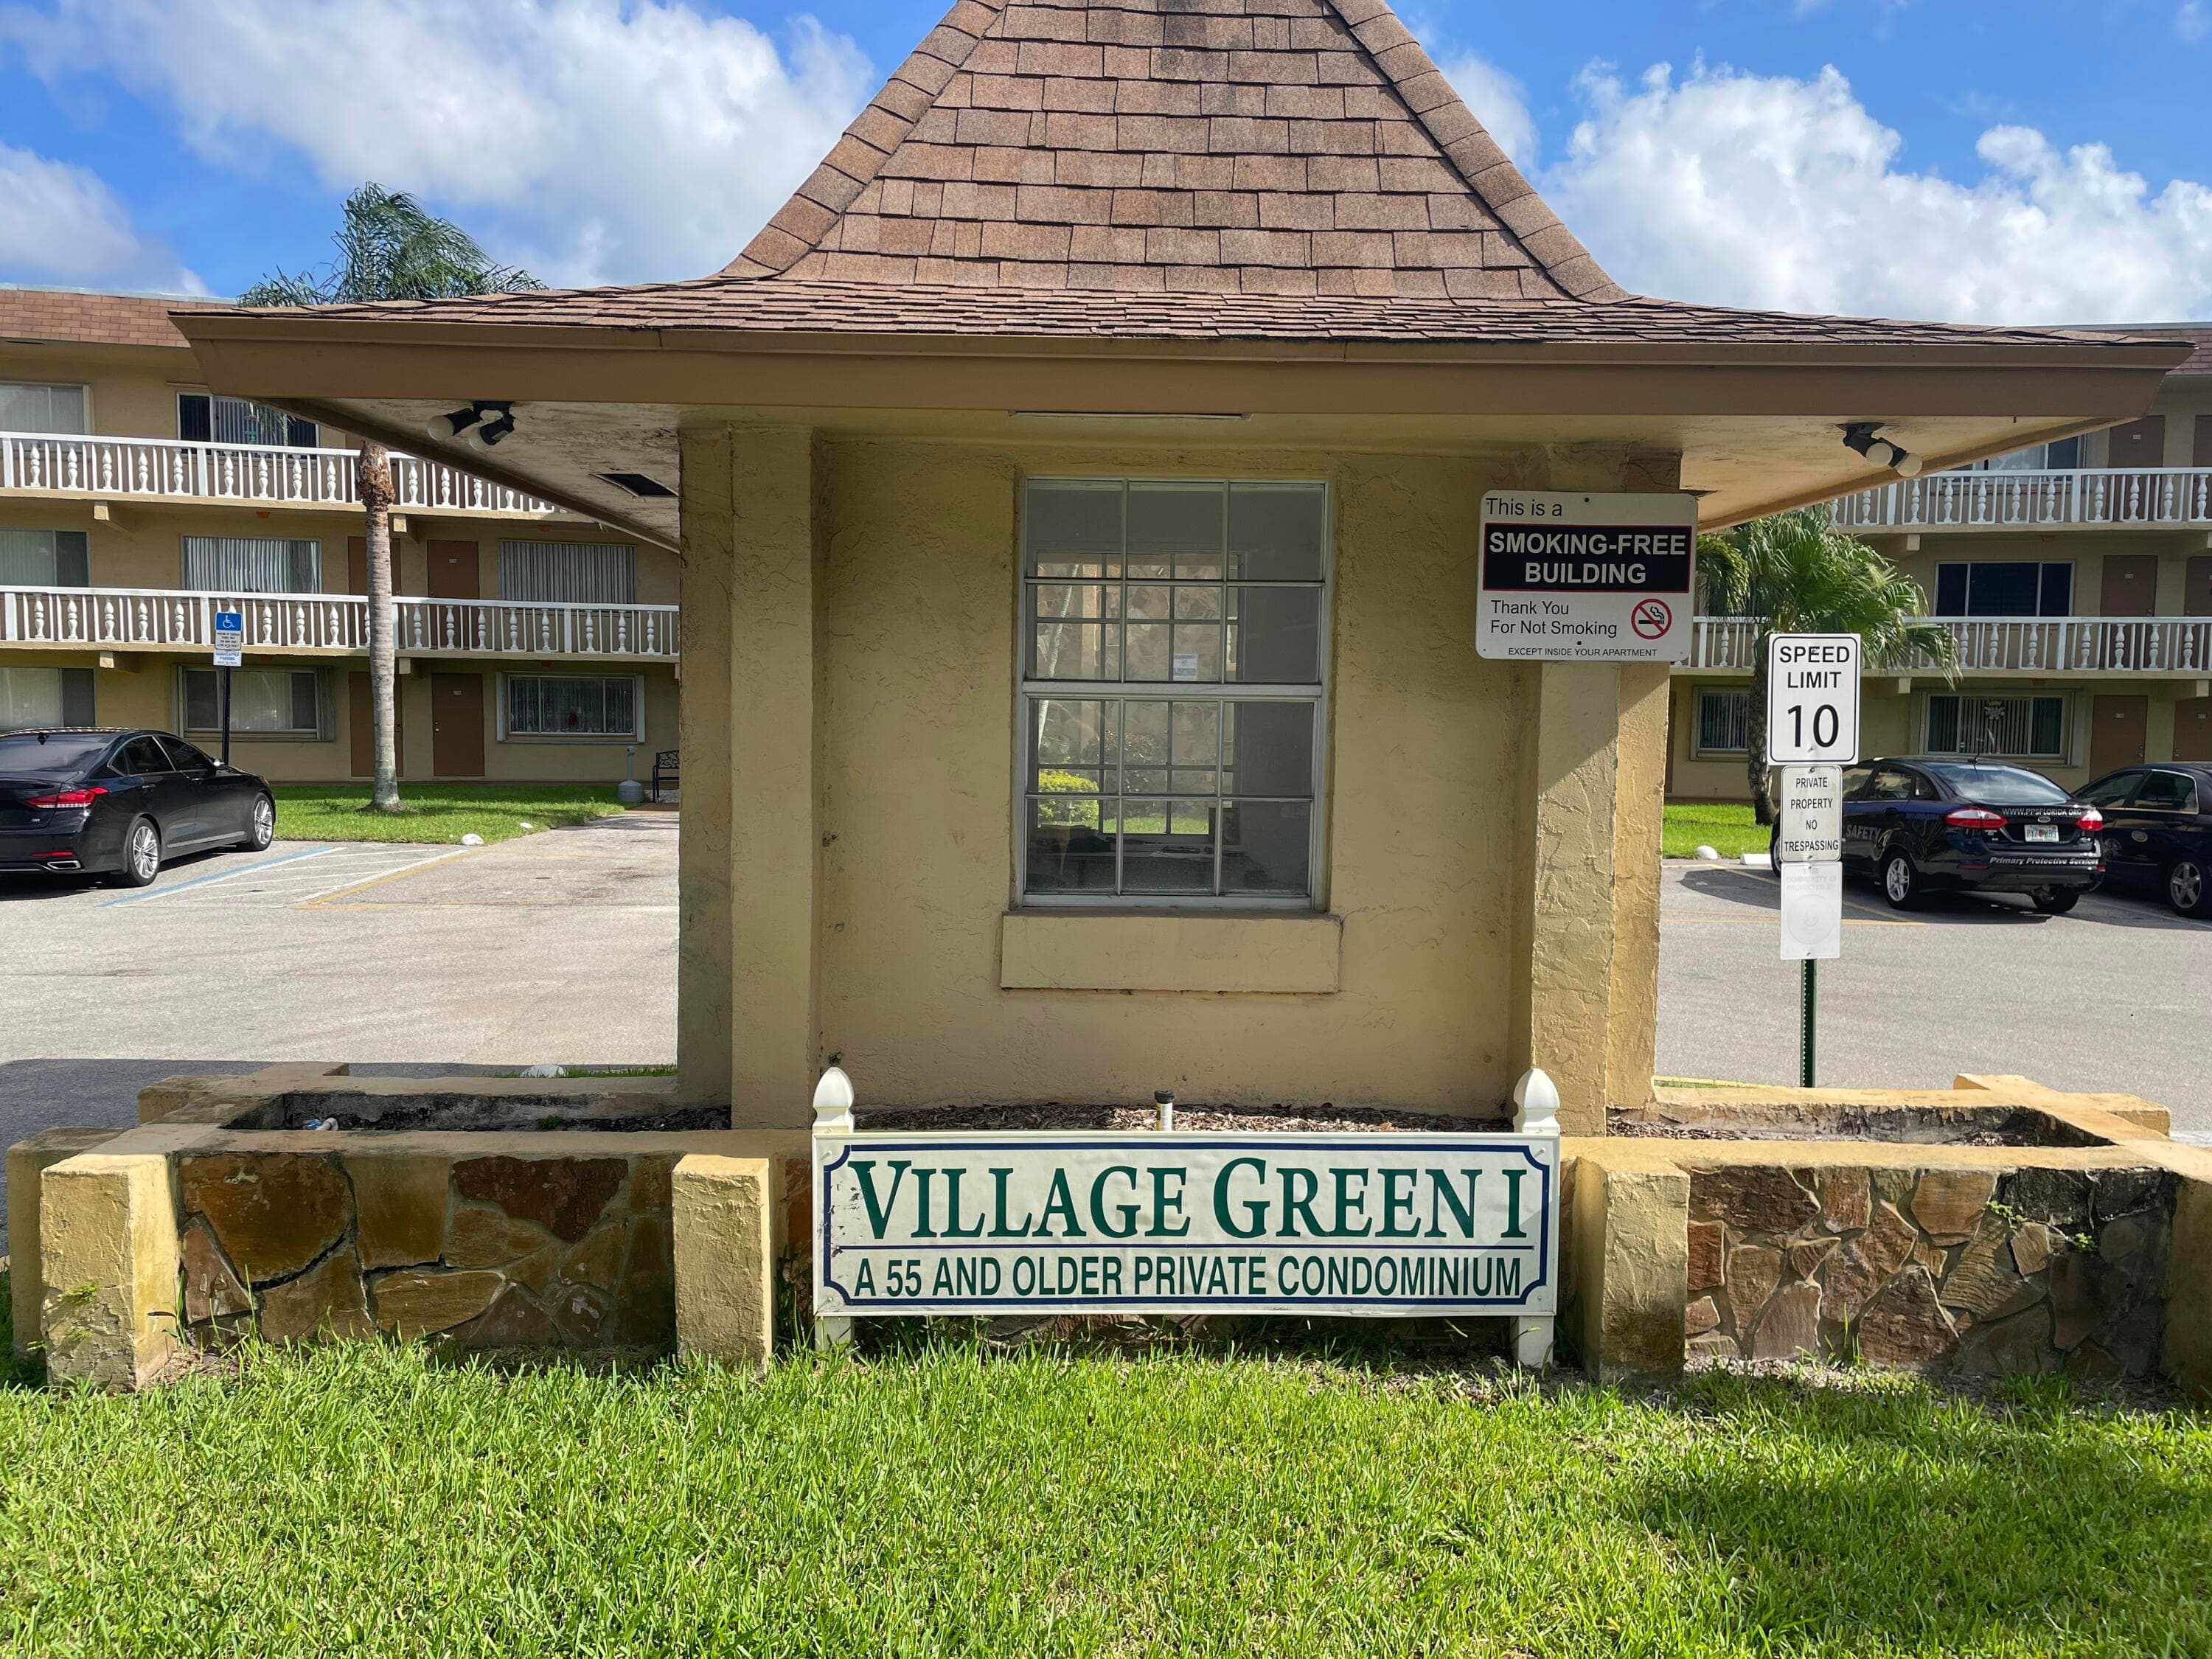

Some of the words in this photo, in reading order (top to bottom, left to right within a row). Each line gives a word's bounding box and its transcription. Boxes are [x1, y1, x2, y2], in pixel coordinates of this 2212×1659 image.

[1486, 498, 1524, 515] This
[1531, 499, 1545, 515] is
[1552, 503, 1562, 516] a
[1489, 532, 1686, 555] SMOKING-FREE
[1525, 563, 1646, 584] BUILDING
[1491, 600, 1537, 614] Thank
[1542, 601, 1569, 615] You
[1491, 620, 1515, 634] For
[1520, 621, 1546, 635] Not
[1551, 621, 1617, 638] Smoking
[1508, 647, 1543, 655] EXCEPT
[1545, 647, 1573, 656] INSIDE
[1575, 648, 1600, 656] YOUR
[1601, 648, 1658, 656] APARTMENT
[1779, 646, 1850, 664] SPEED
[1787, 672, 1842, 689] LIMIT
[1787, 704, 1840, 748] 10
[1795, 777, 1828, 788] PRIVATE
[1790, 798, 1833, 809] PROPERTY
[2002, 807, 2081, 815] WWW.PPSFLORIDAORG
[1806, 820, 1818, 830] NO
[1846, 824, 1880, 841] SAFETY
[1784, 841, 1839, 852] TRESPASSING
[1989, 857, 2023, 865] Primary
[2026, 857, 2067, 865] Protective
[848, 1160, 1191, 1239] VILLAGE
[1214, 1157, 1483, 1238] GREEN
[1500, 1169, 1527, 1238] I
[855, 1258, 876, 1296] A
[886, 1259, 922, 1297] 55
[932, 1257, 1001, 1295] AND
[1012, 1256, 1121, 1295] OLDER
[1134, 1256, 1267, 1295] PRIVATE
[1278, 1255, 1520, 1296] CONDOMINIUM
